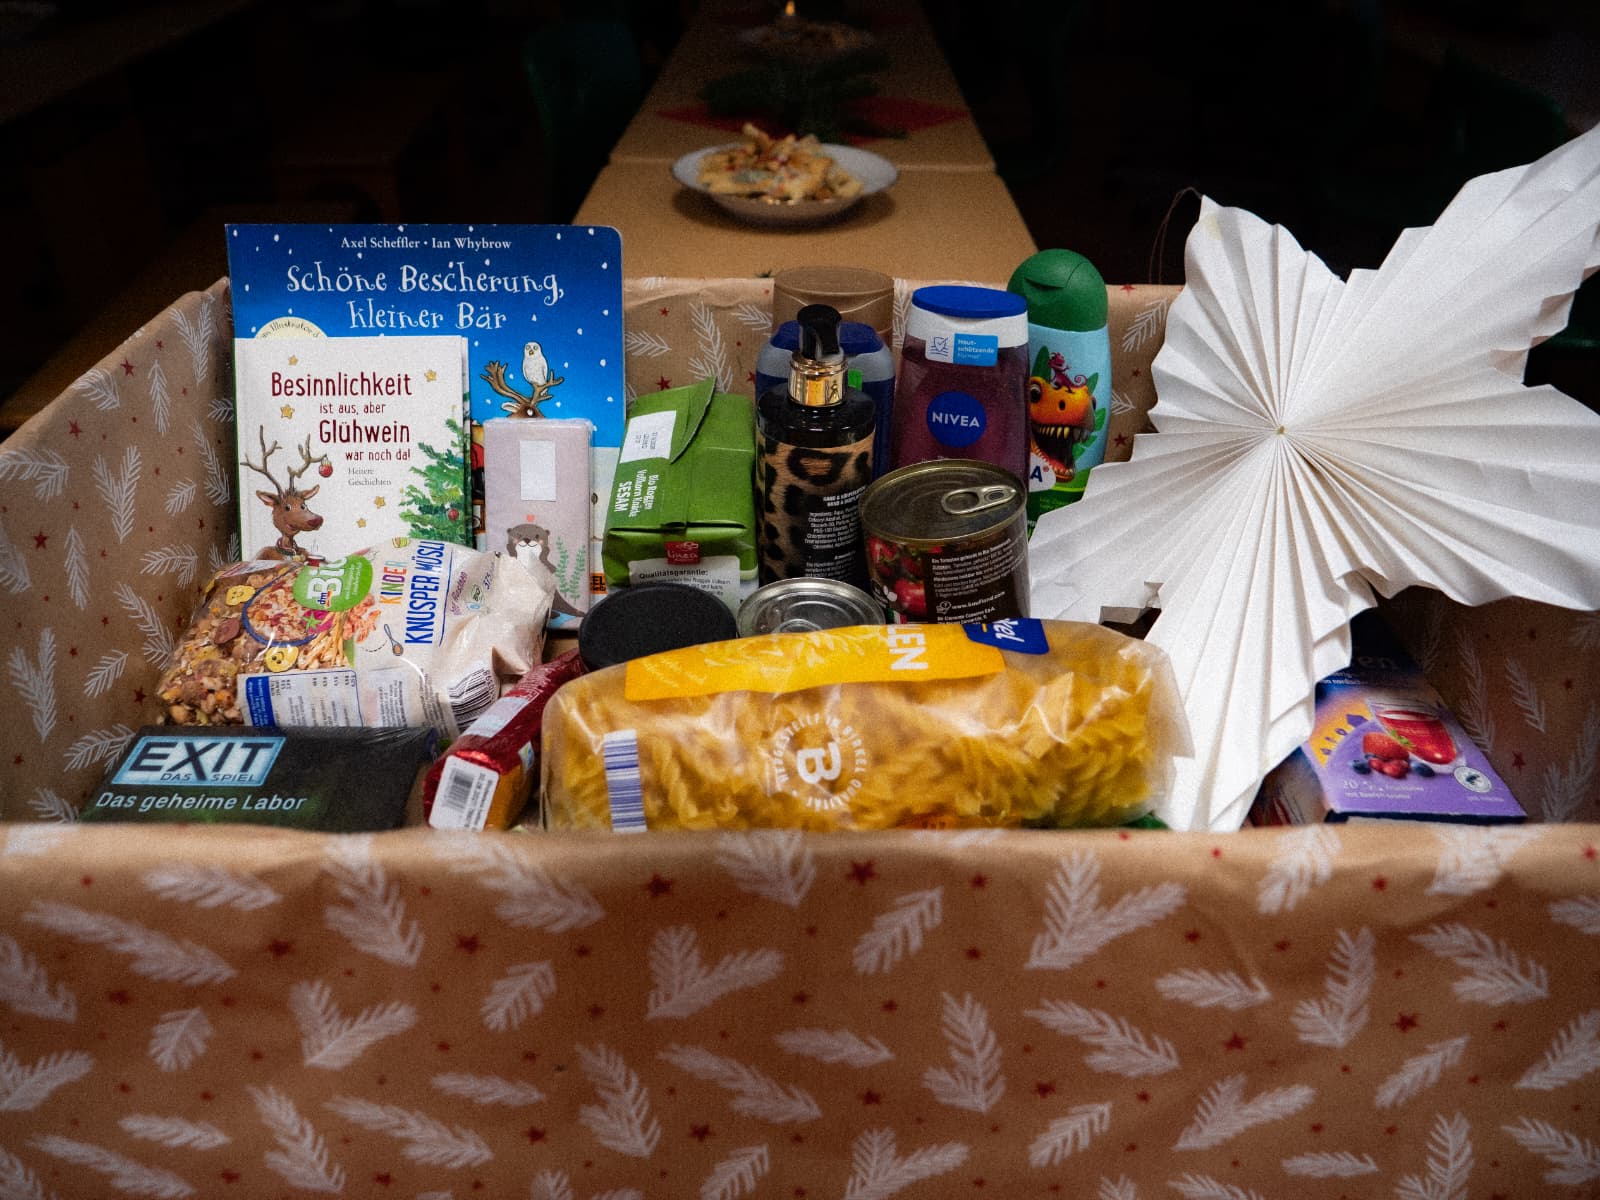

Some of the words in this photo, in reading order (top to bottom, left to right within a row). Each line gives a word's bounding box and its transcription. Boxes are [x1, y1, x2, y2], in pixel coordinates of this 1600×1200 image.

[341, 237, 368, 249] Axel
[370, 236, 420, 249] Scheffler
[431, 237, 451, 249] Ian
[455, 237, 512, 252] Whybrow
[287, 261, 387, 293] Schöne
[398, 262, 565, 306] Bescherung,
[347, 298, 443, 330] kleiner
[455, 302, 507, 330] Bär
[271, 371, 412, 397] Besinnlichkeit
[319, 402, 334, 414] ist
[338, 403, 360, 416] aus,
[363, 401, 386, 414] aber
[931, 412, 981, 429] NIVEA
[319, 418, 410, 443] Glühwein
[345, 451, 365, 461] war
[368, 448, 392, 461] noch
[613, 480, 633, 512] SESAM
[411, 540, 446, 574] MÜSLI
[378, 560, 409, 605] KINDER
[316, 592, 327, 606] dm
[404, 574, 440, 645] KNUSPER
[128, 741, 275, 782] EXIT
[159, 772, 193, 782] DAS
[210, 773, 257, 783] SPIEL
[95, 791, 137, 809] Das
[138, 792, 239, 813] geheime
[241, 793, 308, 812] Labor
